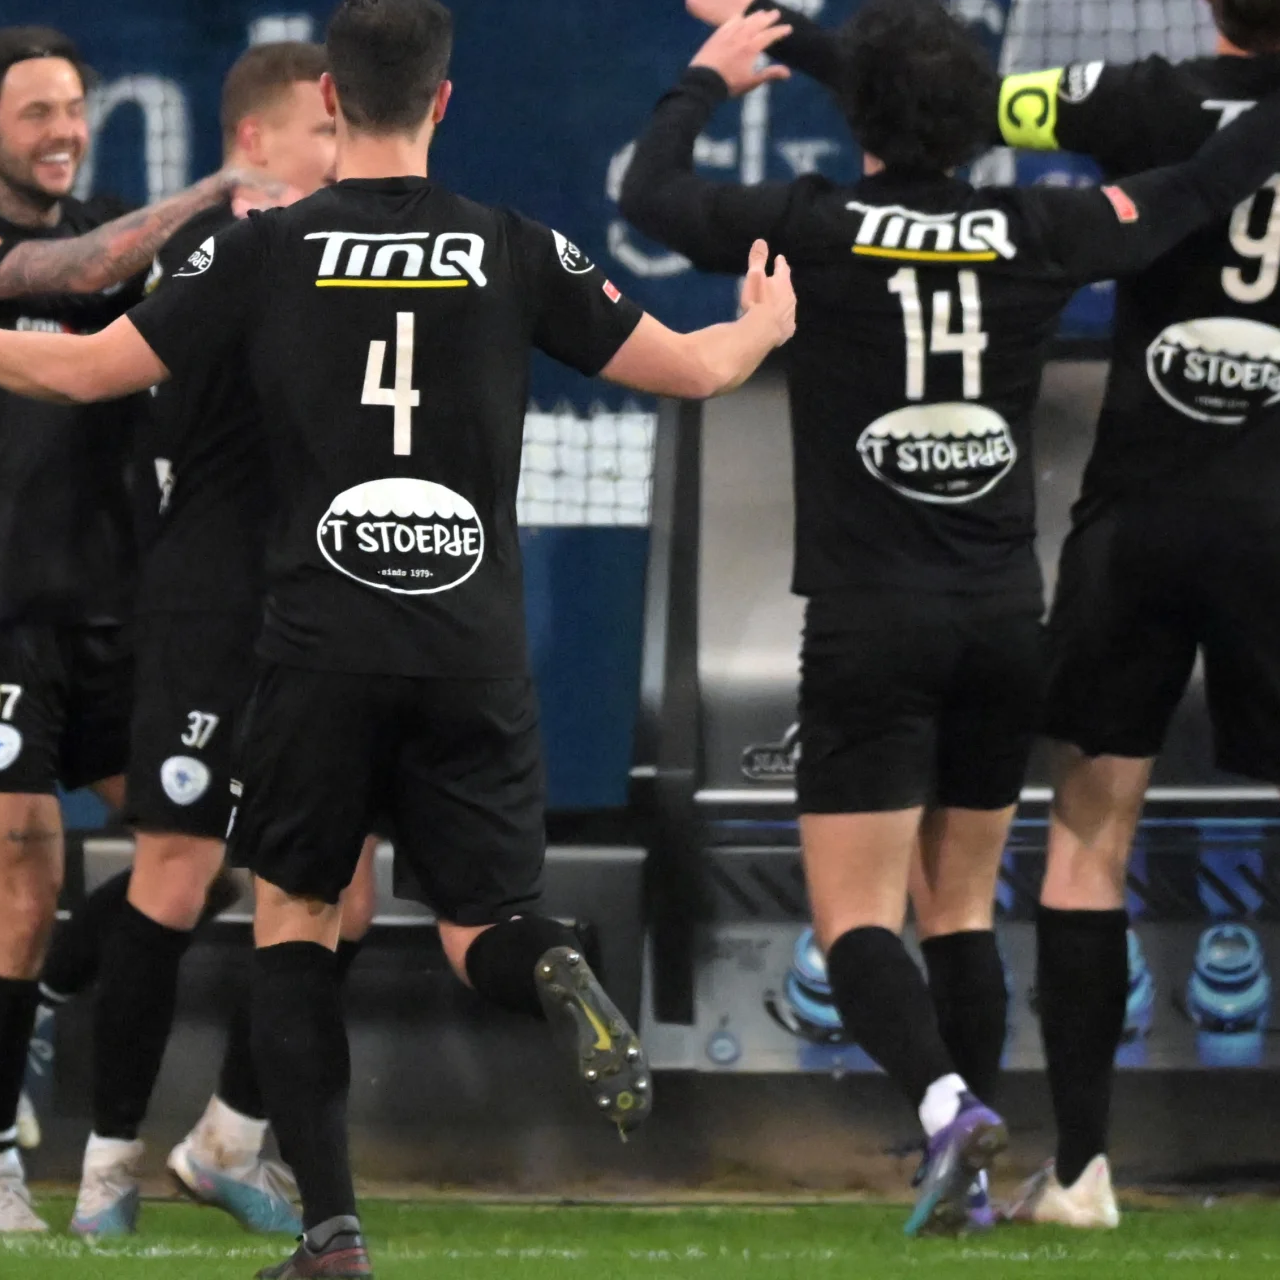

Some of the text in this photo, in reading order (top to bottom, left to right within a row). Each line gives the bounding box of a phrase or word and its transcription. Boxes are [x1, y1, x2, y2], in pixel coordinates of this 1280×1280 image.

[1006, 86, 1050, 129] C
[887, 266, 989, 400] 14
[361, 312, 420, 456] 4
[355, 521, 479, 557] STOEPJE
[180, 709, 220, 750] 37
